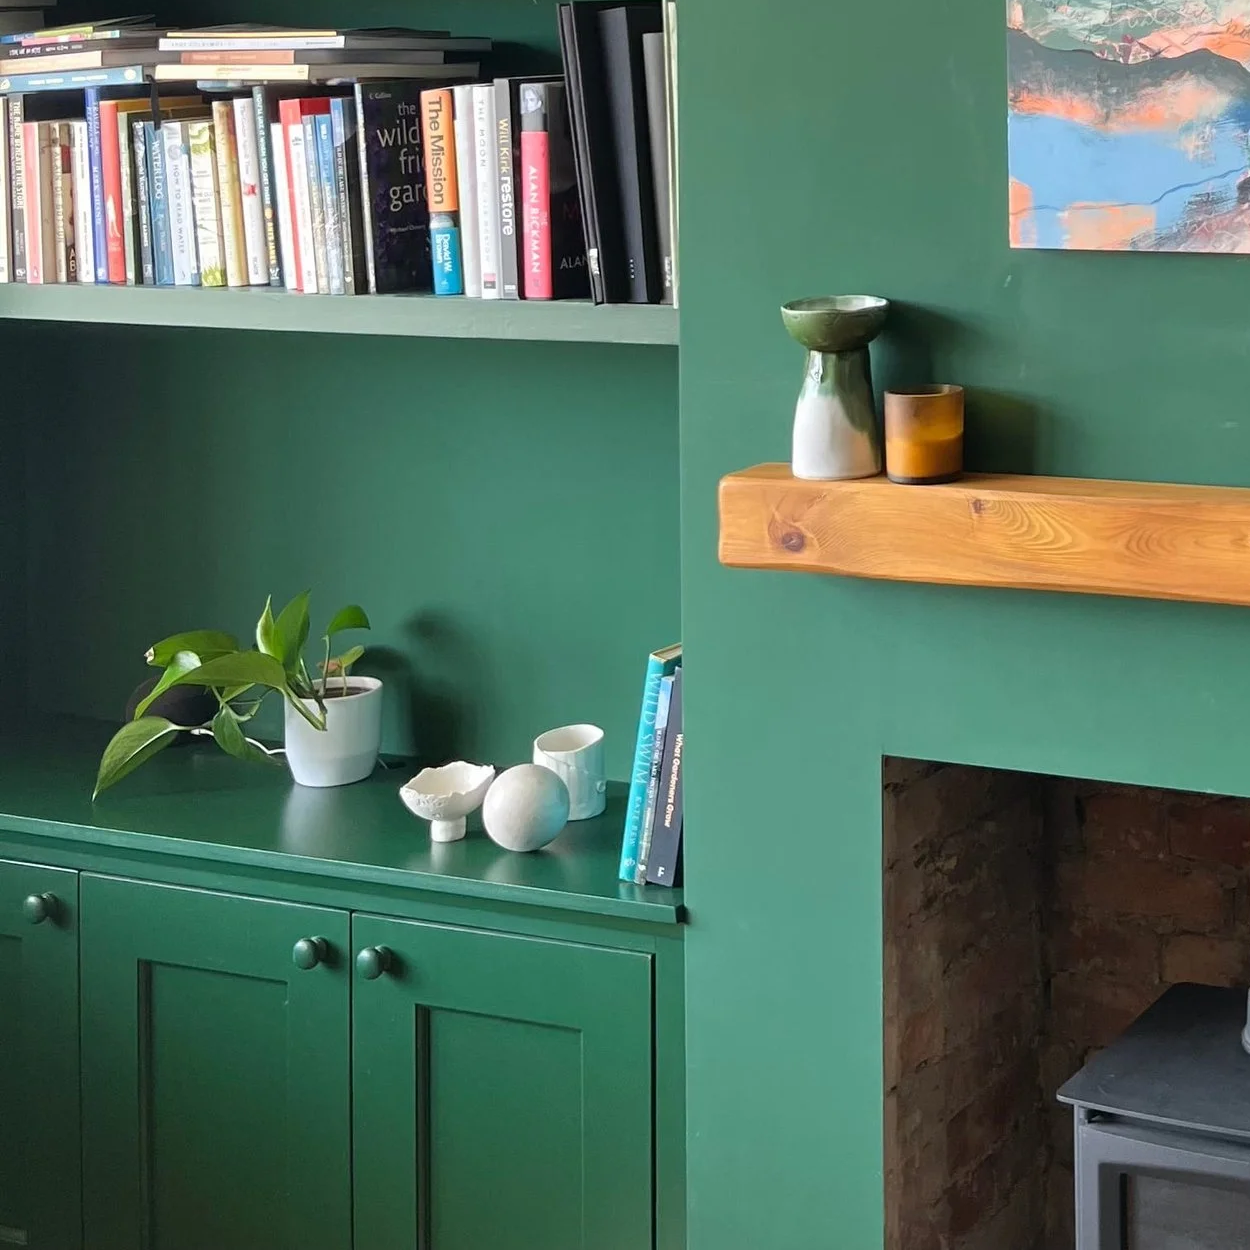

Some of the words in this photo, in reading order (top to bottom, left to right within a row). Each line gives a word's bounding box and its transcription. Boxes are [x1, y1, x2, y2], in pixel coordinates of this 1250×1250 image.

[398, 102, 416, 116] the
[428, 97, 442, 131] The
[377, 119, 420, 148] wild
[498, 118, 509, 143] Will
[152, 140, 163, 199] WATERLOG
[430, 135, 446, 204] Mission
[499, 147, 510, 174] Kirk
[528, 166, 539, 201] ALAN
[501, 176, 514, 236] restore
[435, 234, 443, 263] Brown
[441, 234, 450, 260] David
[530, 207, 541, 273] RICKMAN
[643, 672, 663, 724] WILD
[636, 733, 654, 784] SWIM
[675, 733, 684, 764] What
[668, 763, 681, 807] Gardeners
[664, 806, 674, 828] Grow
